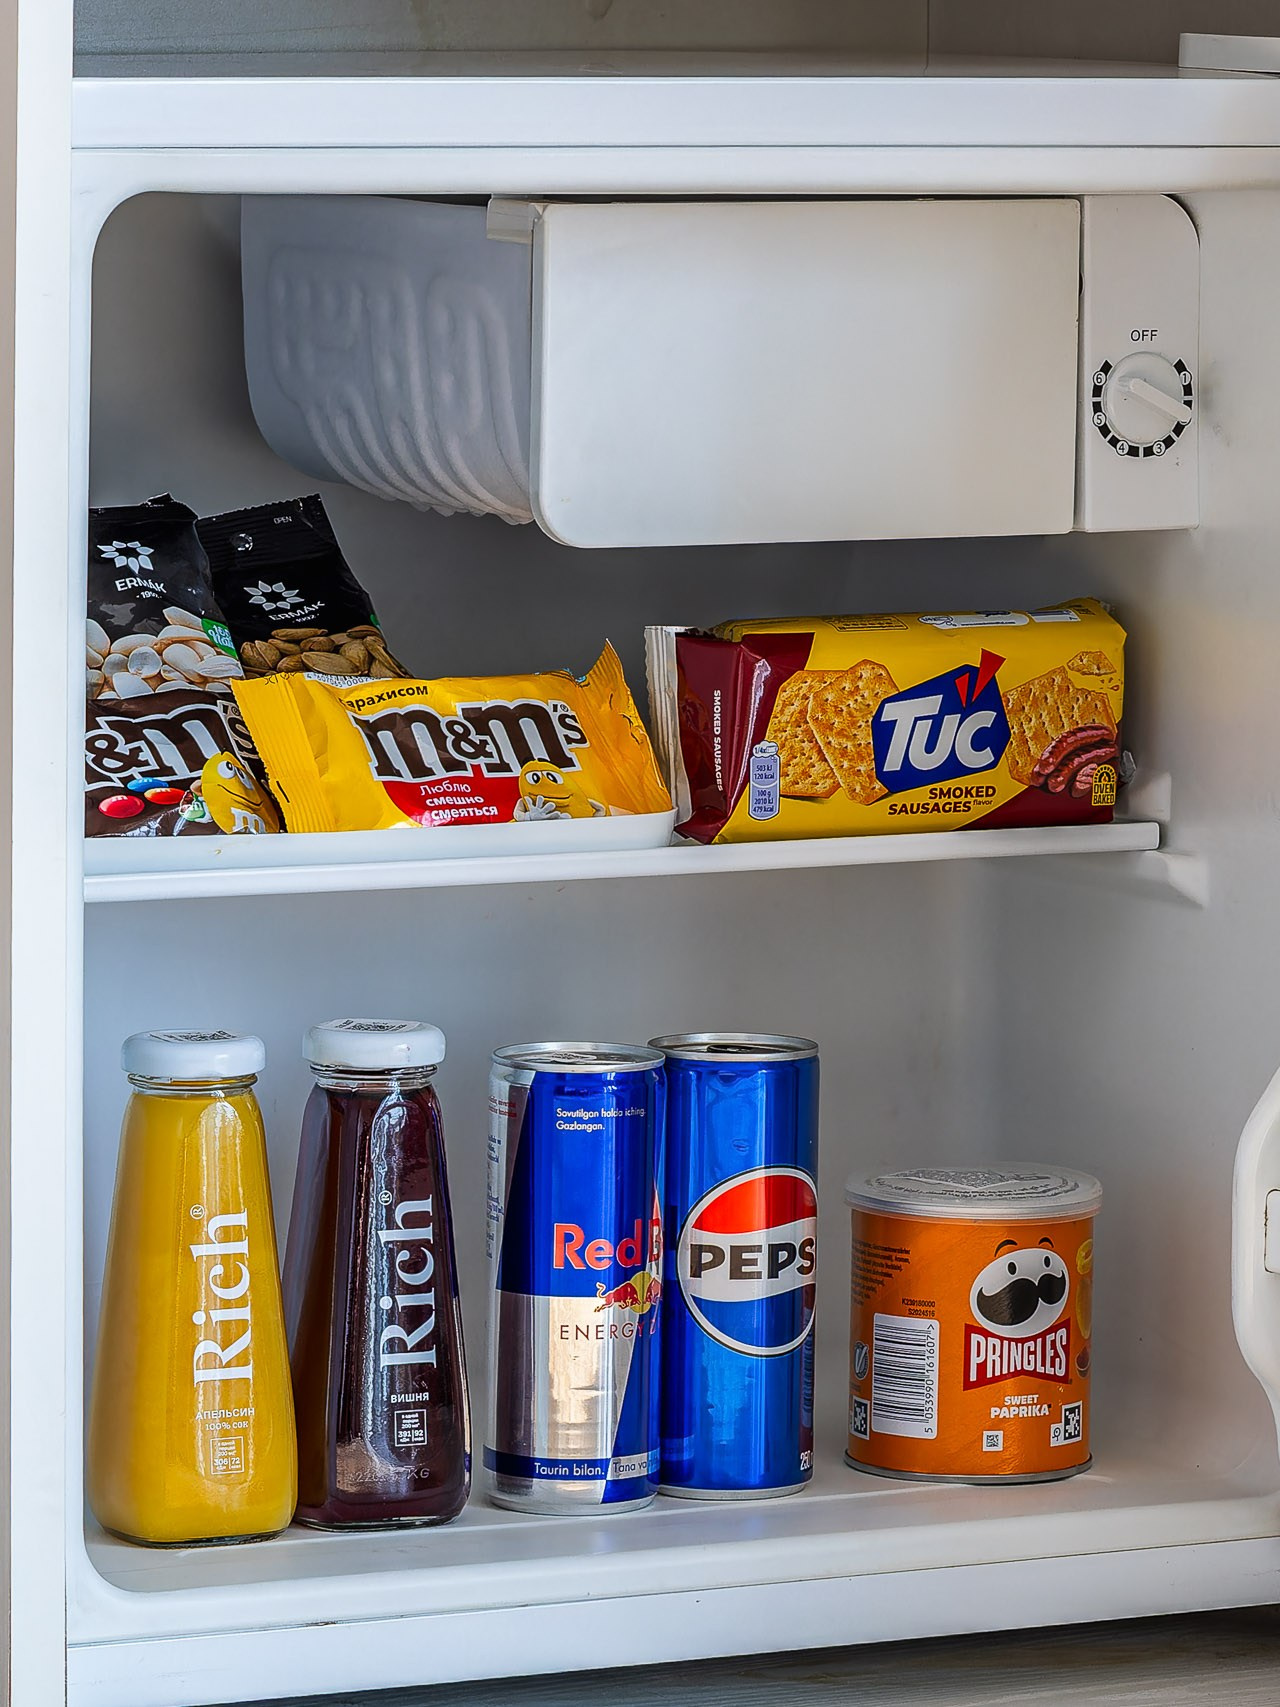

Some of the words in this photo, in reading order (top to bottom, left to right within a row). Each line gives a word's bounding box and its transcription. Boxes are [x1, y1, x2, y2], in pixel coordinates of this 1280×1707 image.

[1130, 329, 1159, 342] OFF
[1096, 374, 1103, 384] 6
[1096, 414, 1103, 425] 5
[1118, 443, 1126, 454] 4
[1156, 443, 1162, 454] 3
[274, 516, 292, 524] OPEN
[713, 689, 721, 735] SMOKED
[713, 736, 724, 792] SAUSAGES
[764, 772, 775, 780] kcal
[420, 781, 471, 796] Люблю
[928, 785, 997, 800] SMOKED
[1093, 783, 1115, 795] OVEN
[426, 795, 484, 808] смешно
[1093, 794, 1115, 805] BAKED
[431, 806, 498, 821] смеяться
[763, 805, 774, 813] kcal
[888, 801, 972, 816] SAUSAGES
[556, 1107, 599, 1120] Sovutilgan
[600, 1107, 623, 1118] holda
[555, 1120, 605, 1133] Gazlangan.
[553, 1219, 642, 1270] Red
[689, 1237, 816, 1281] PEPS
[379, 1193, 437, 1370] Rich
[190, 1207, 253, 1387] Rich
[560, 1321, 644, 1340] ENERGY
[926, 1335, 935, 1374] 161607
[970, 1328, 1067, 1382] PRINGLES
[390, 1392, 429, 1403] ВИШНЯ
[924, 1379, 934, 1419] 053990
[1004, 1394, 1039, 1406] SWEET
[195, 1407, 255, 1420] АПЕЛЬСИН
[990, 1404, 1050, 1419] PAPRIKA
[205, 1422, 231, 1430] 100%
[397, 1430, 412, 1438] 391
[231, 1457, 240, 1465] 72
[612, 1461, 636, 1473] Tana
[534, 1463, 569, 1476] Taurin
[573, 1463, 605, 1476] bilan.
